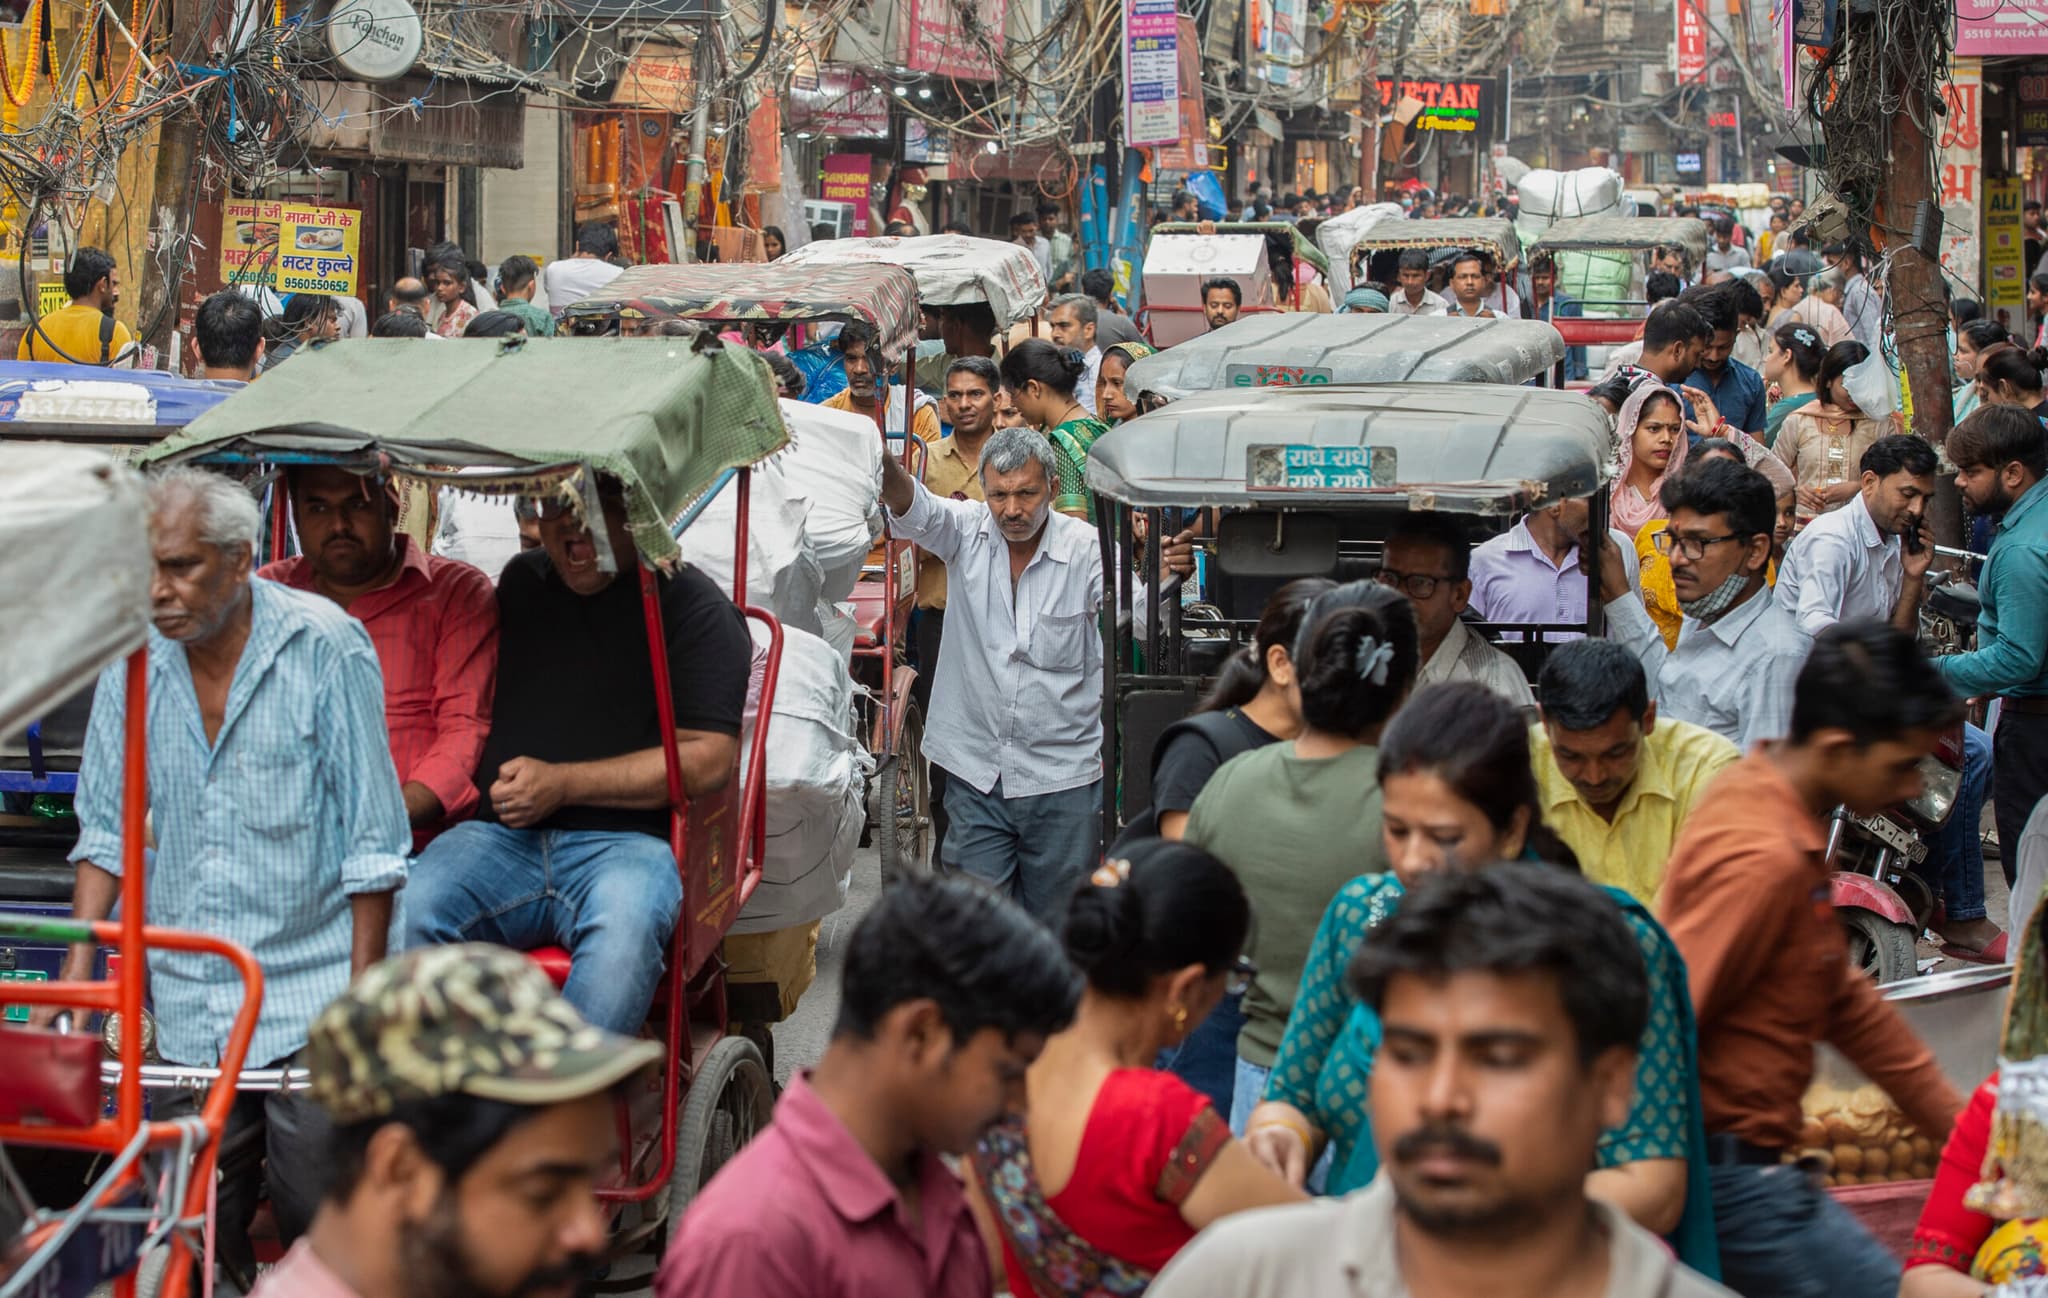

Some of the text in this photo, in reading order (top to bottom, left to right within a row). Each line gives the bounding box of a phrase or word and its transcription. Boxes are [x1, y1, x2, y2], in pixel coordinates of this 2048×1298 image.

[349, 14, 405, 46] Kanchan
[1994, 28, 2035, 39] KATRA
[824, 172, 870, 185] SANJANA
[826, 186, 867, 199] FABRICS
[1990, 192, 2018, 211] ALI
[285, 210, 354, 227] मामा जी के
[282, 255, 315, 271] मटर
[317, 254, 354, 278] कुल्चे
[284, 277, 349, 293] 9560550652
